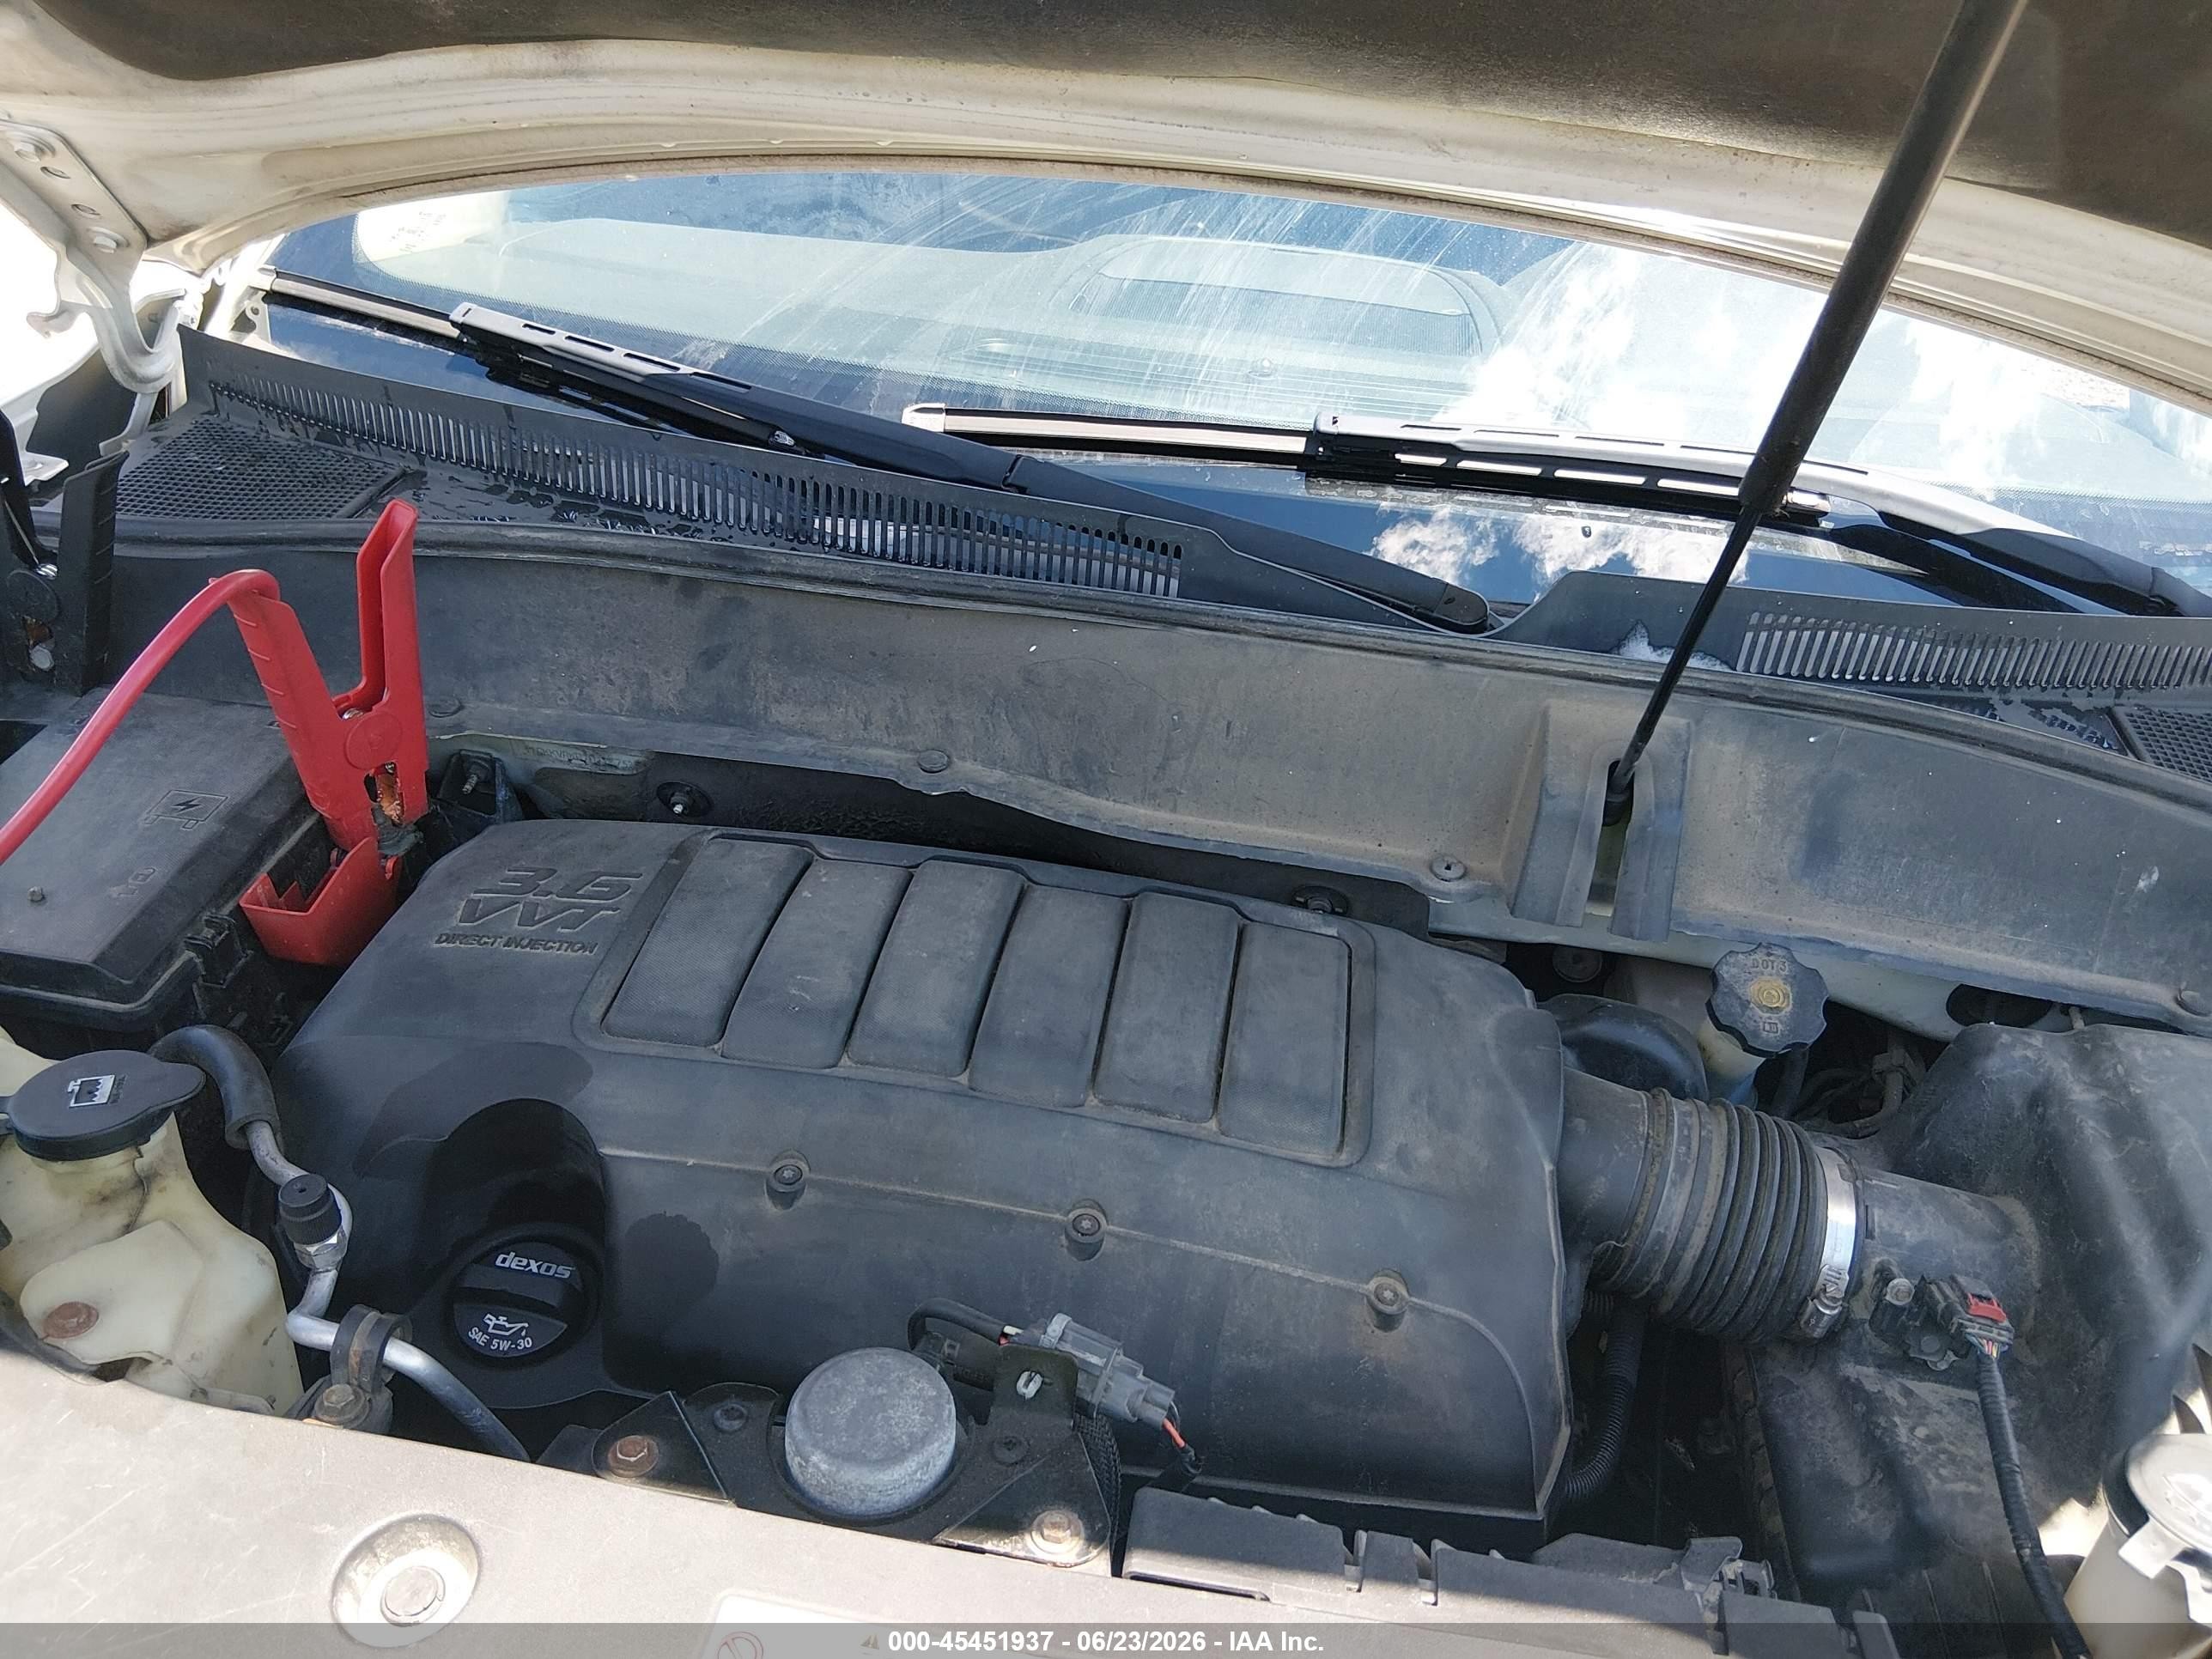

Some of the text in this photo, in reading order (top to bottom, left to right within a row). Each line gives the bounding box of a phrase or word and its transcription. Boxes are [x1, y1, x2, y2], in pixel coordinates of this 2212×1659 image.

[472, 867, 642, 902] 3.6
[459, 898, 620, 933] VVT
[434, 933, 599, 955] DIRECT INJECTION
[1751, 958, 1776, 970] DOT
[495, 1251, 576, 1279] dexos
[468, 1327, 532, 1351] SAE 5W-30
